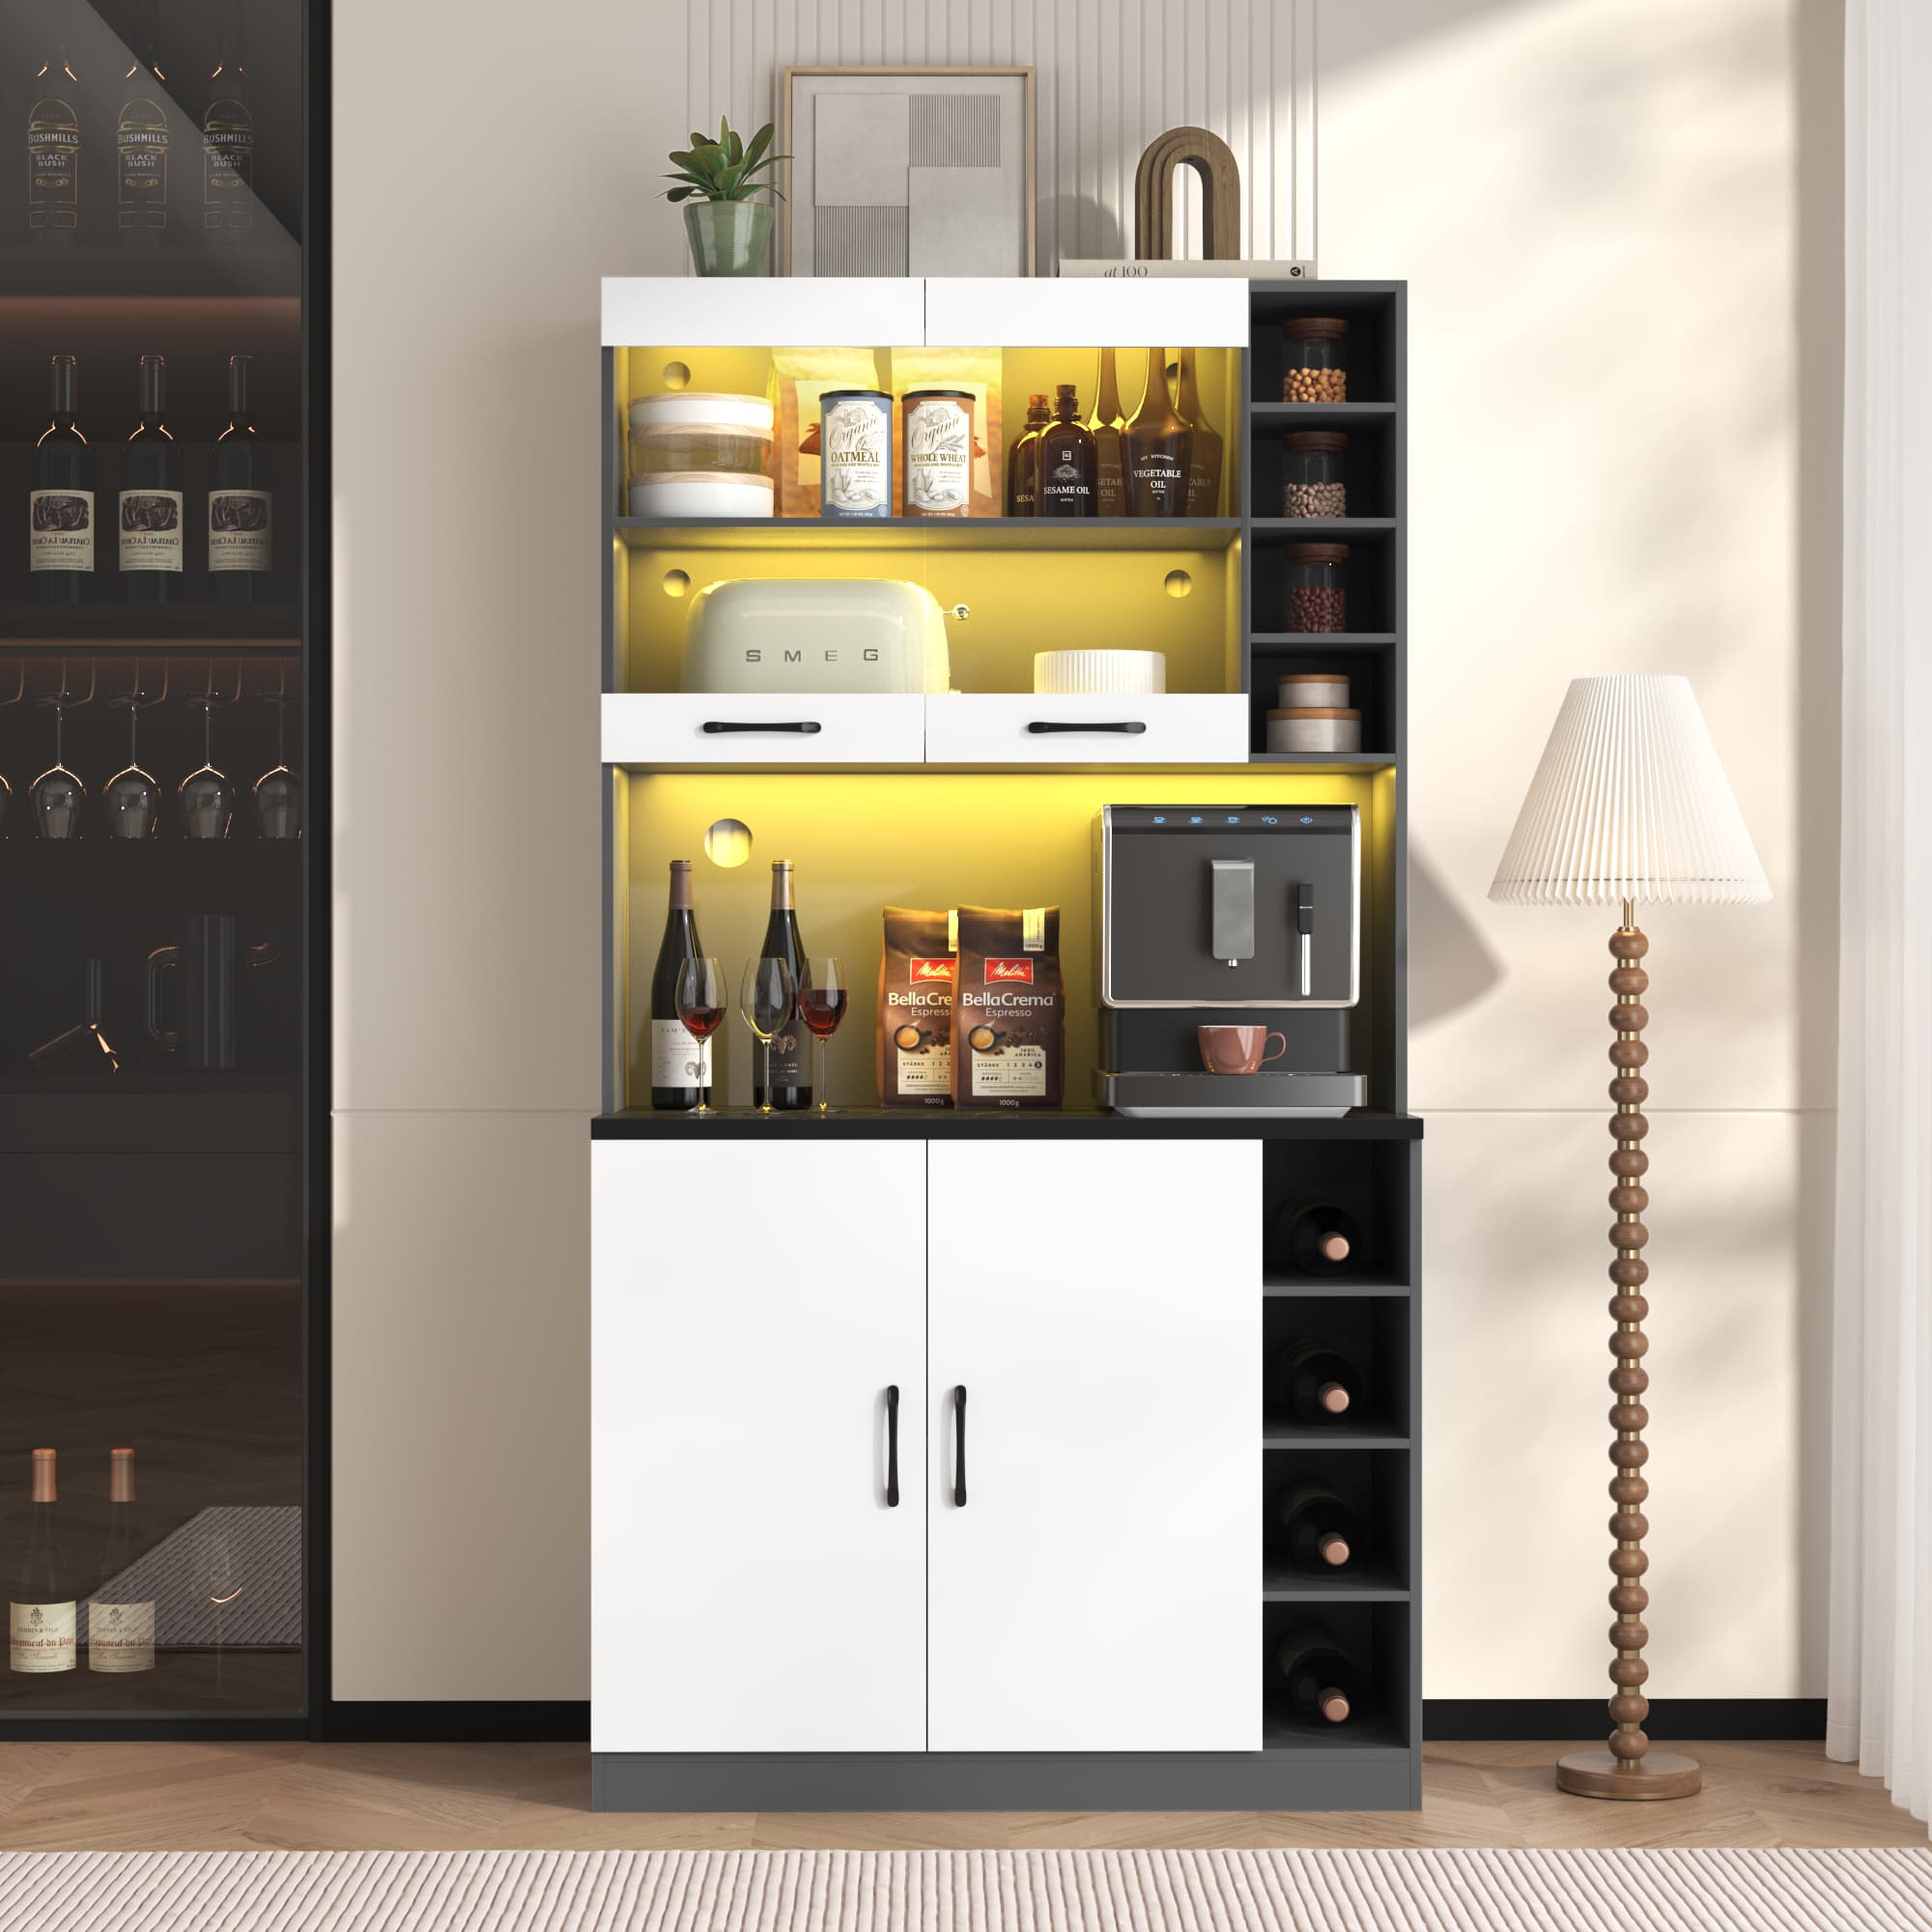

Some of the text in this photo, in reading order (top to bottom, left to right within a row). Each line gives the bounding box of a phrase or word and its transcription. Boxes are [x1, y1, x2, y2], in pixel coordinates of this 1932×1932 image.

[28, 131, 78, 144] BUSHMILLS
[117, 131, 168, 144] BUSHMILLS
[203, 131, 254, 144] BUSHMILLS
[1122, 266, 1148, 277] 100
[831, 451, 880, 463] OATMEAL
[911, 454, 967, 463] WHOLE WHEAT
[1133, 469, 1182, 478] VEGETABLE
[1043, 486, 1090, 495] SESAME OIL
[1150, 480, 1167, 489] OIL
[1015, 494, 1036, 503] SESA
[746, 648, 879, 663] SMEG
[916, 961, 952, 978] Melitta
[990, 961, 1027, 978] Melitta
[888, 991, 952, 1006] BellaCre
[963, 991, 1054, 1007] BellaCrema
[911, 1007, 951, 1017] Espress
[985, 1008, 1033, 1018] Espresso
